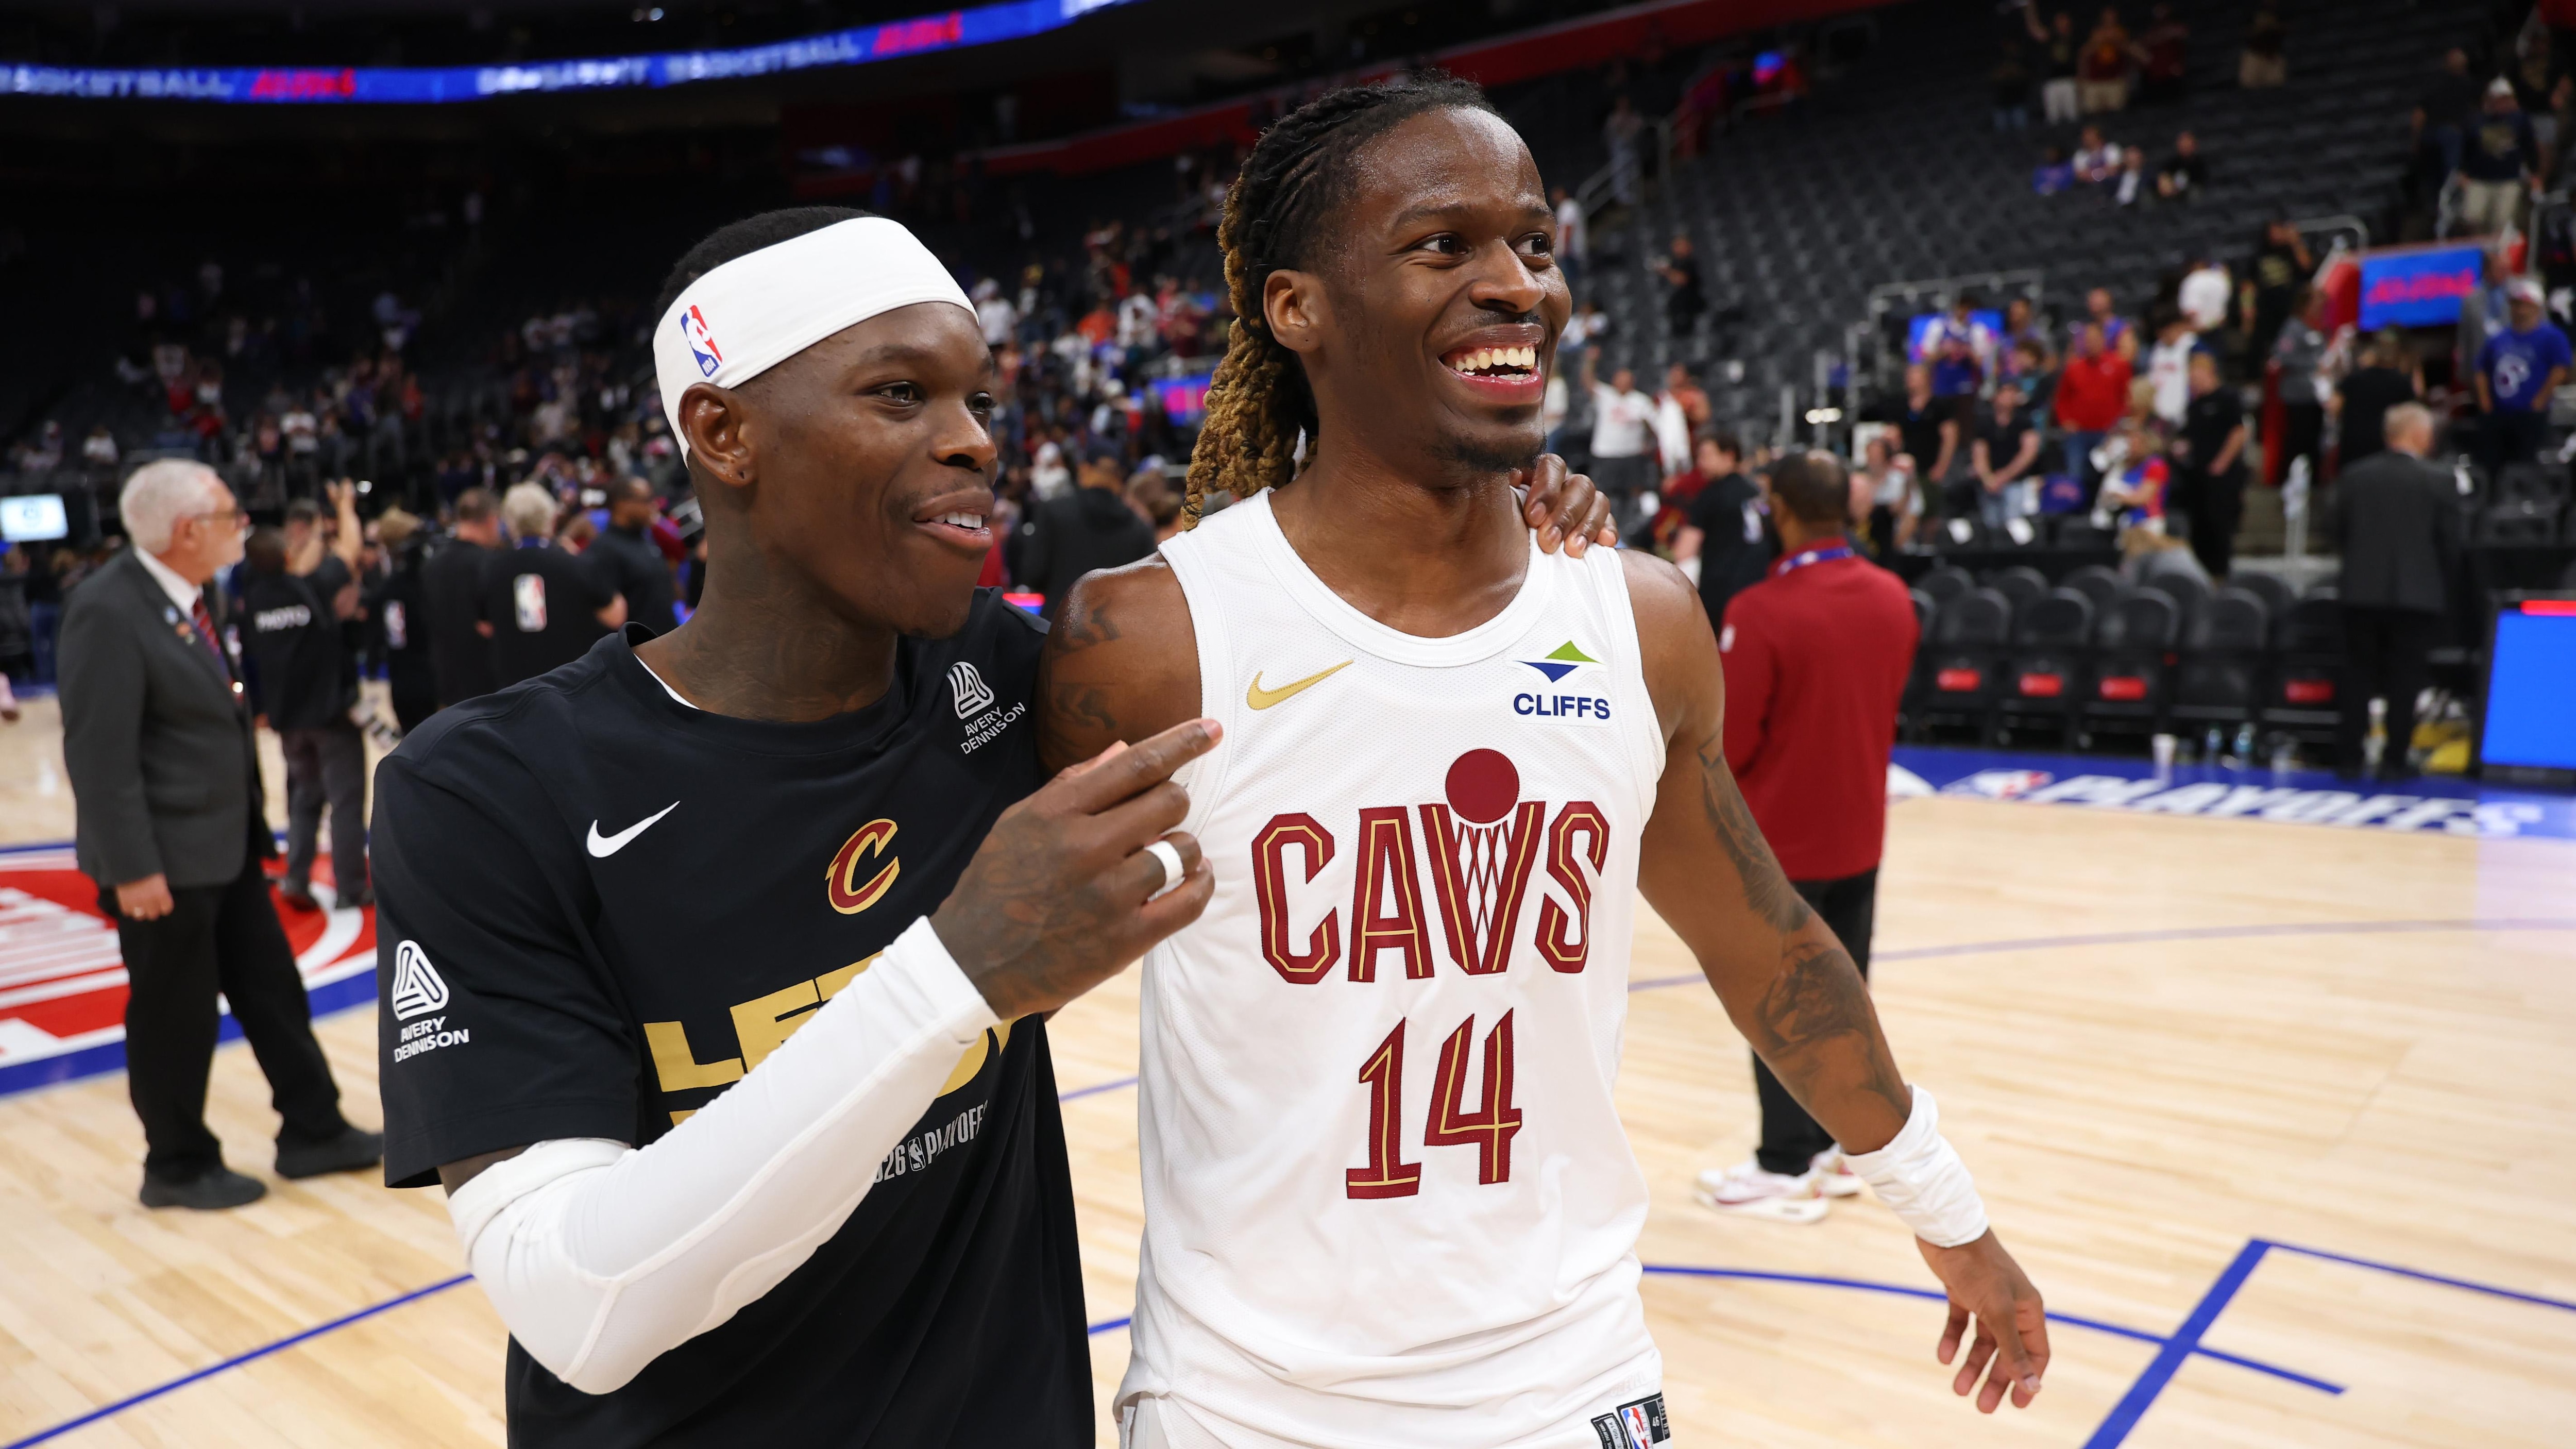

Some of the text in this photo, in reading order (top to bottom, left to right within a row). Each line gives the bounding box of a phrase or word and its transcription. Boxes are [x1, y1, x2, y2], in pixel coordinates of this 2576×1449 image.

[702, 357, 716, 375] NBA
[964, 706, 1003, 736] AVERY
[1513, 692, 1611, 720] CLIFFS
[960, 702, 1026, 755] DENNISON
[1251, 801, 1611, 984] CAVS
[400, 1016, 447, 1043] AVERY
[643, 951, 883, 1092] LE
[394, 1029, 469, 1063] DENNISON
[1346, 1007, 1522, 1200] 14
[1652, 1416, 1660, 1427] 46
